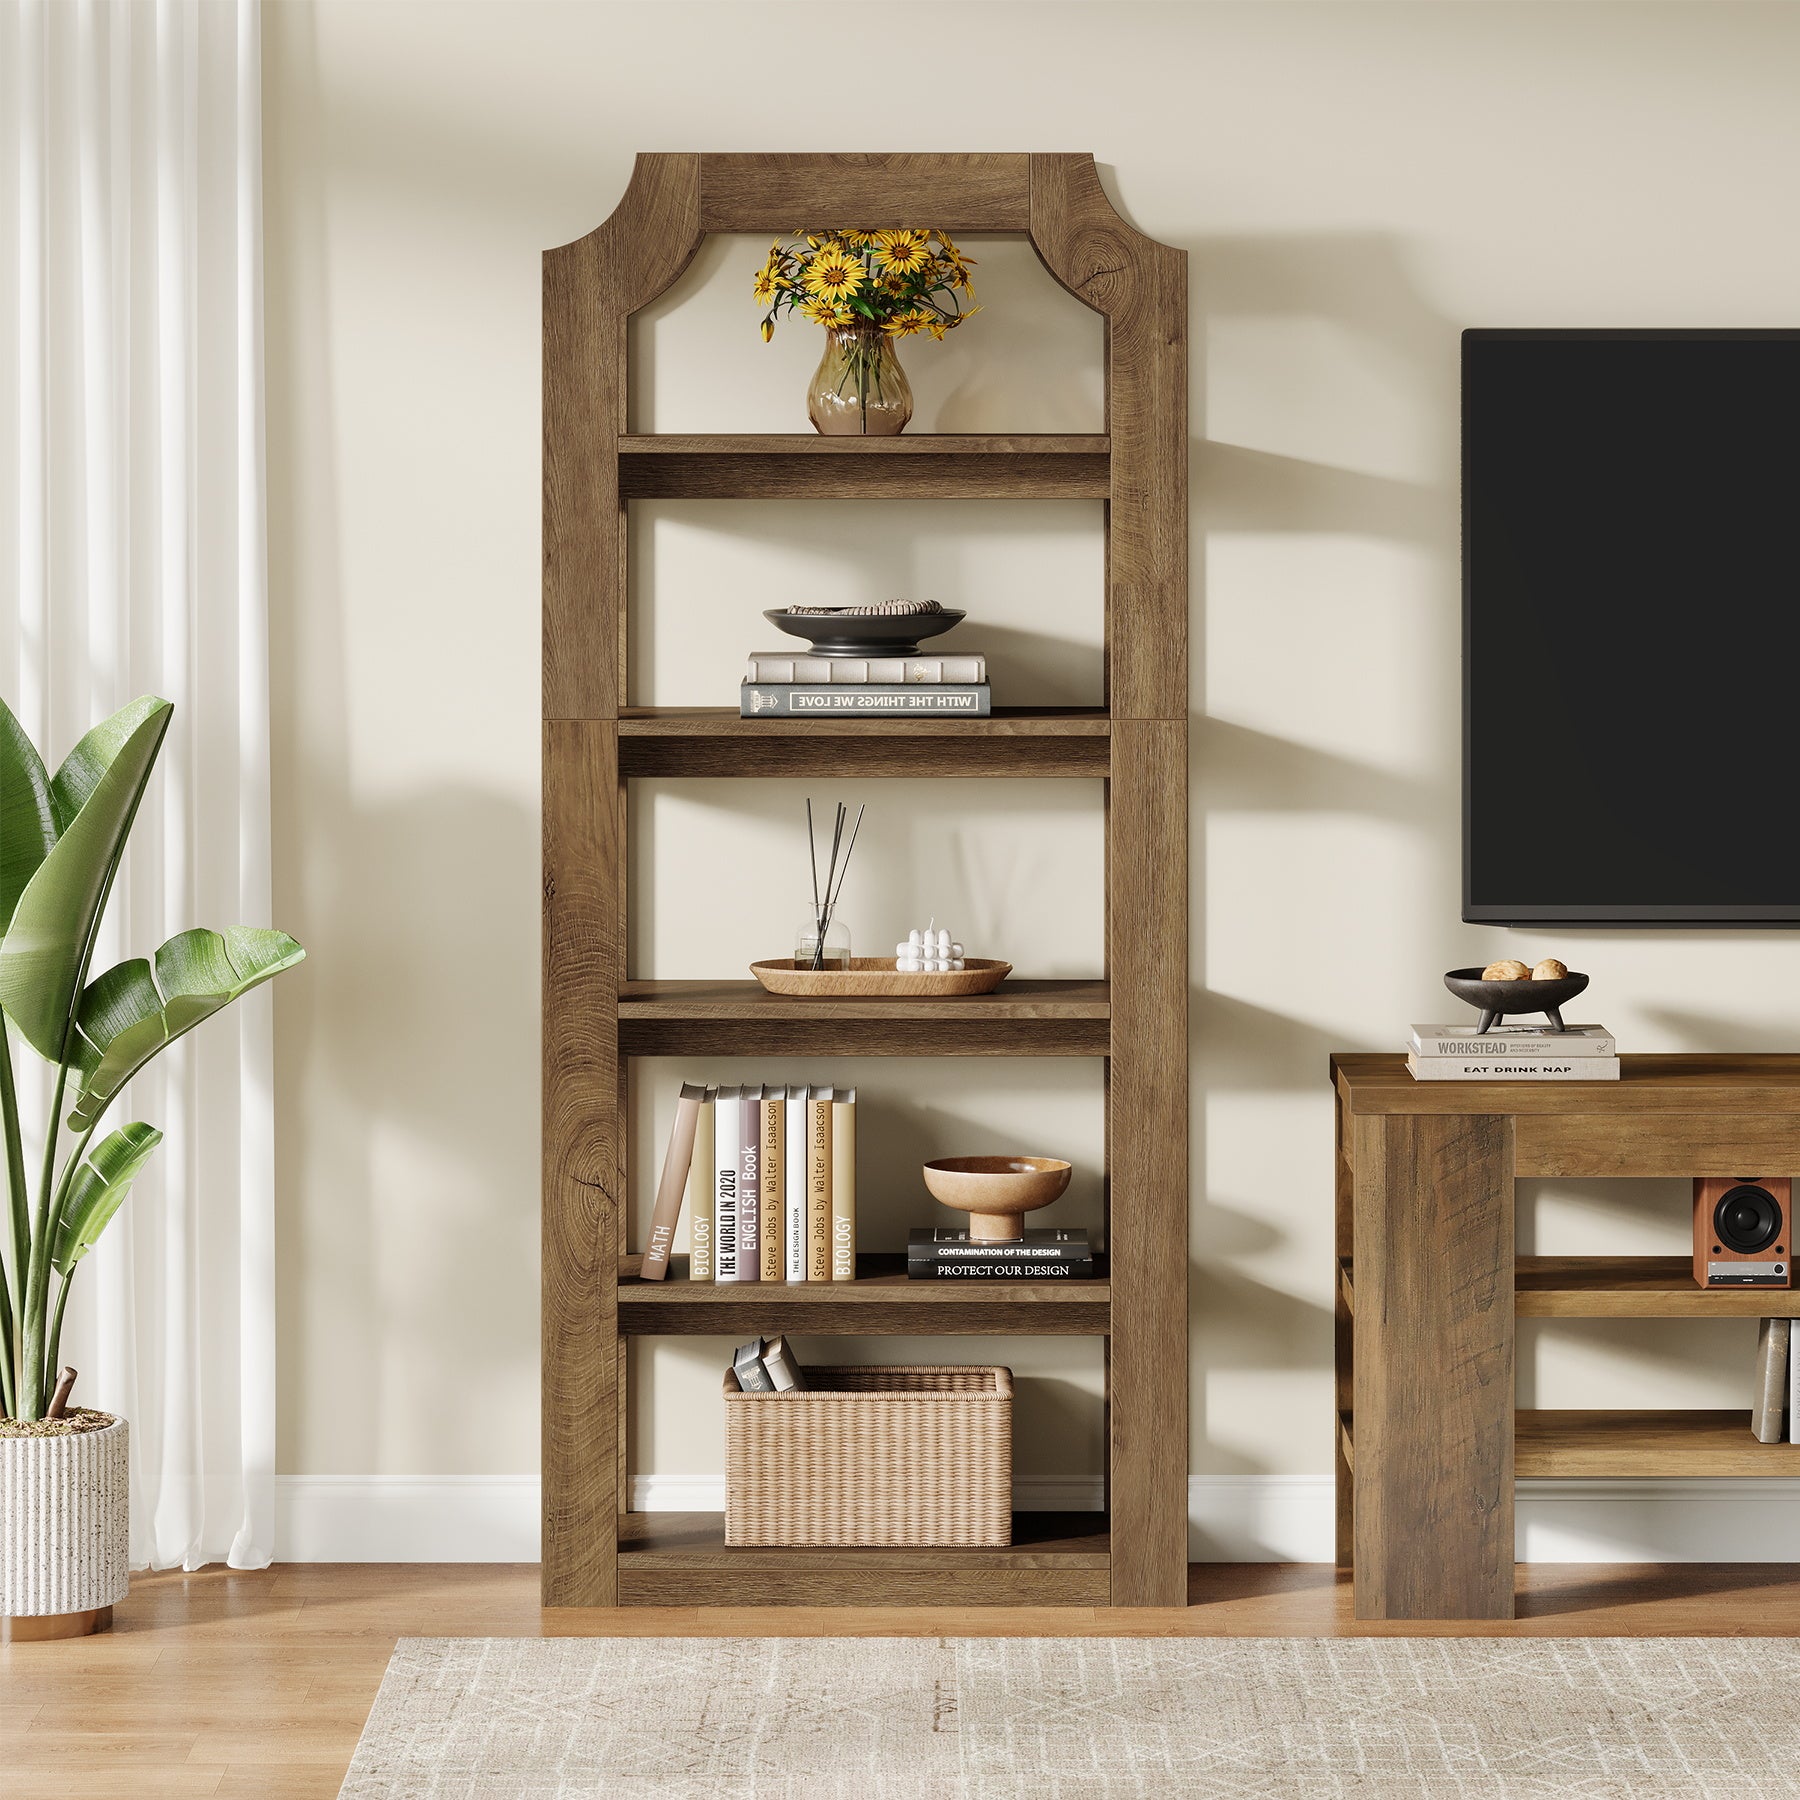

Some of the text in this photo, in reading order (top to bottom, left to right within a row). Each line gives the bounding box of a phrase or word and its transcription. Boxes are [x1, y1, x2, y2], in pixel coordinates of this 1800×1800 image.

[1438, 1042, 1507, 1054] WORKSTEAD
[742, 1145, 756, 1250] ENGLISH Book
[766, 1102, 779, 1277] Steve Jobs by Walter Isaacson
[814, 1102, 827, 1277] Steve Jobs by Walter Isaacson
[648, 1225, 670, 1261] MATH
[694, 1216, 709, 1275] BIOLOGY
[720, 1170, 736, 1275] THE WORLD IN 2020
[836, 1215, 851, 1274] BIOLOGY
[938, 1266, 1069, 1275] PROTECT OUR DESIGN
